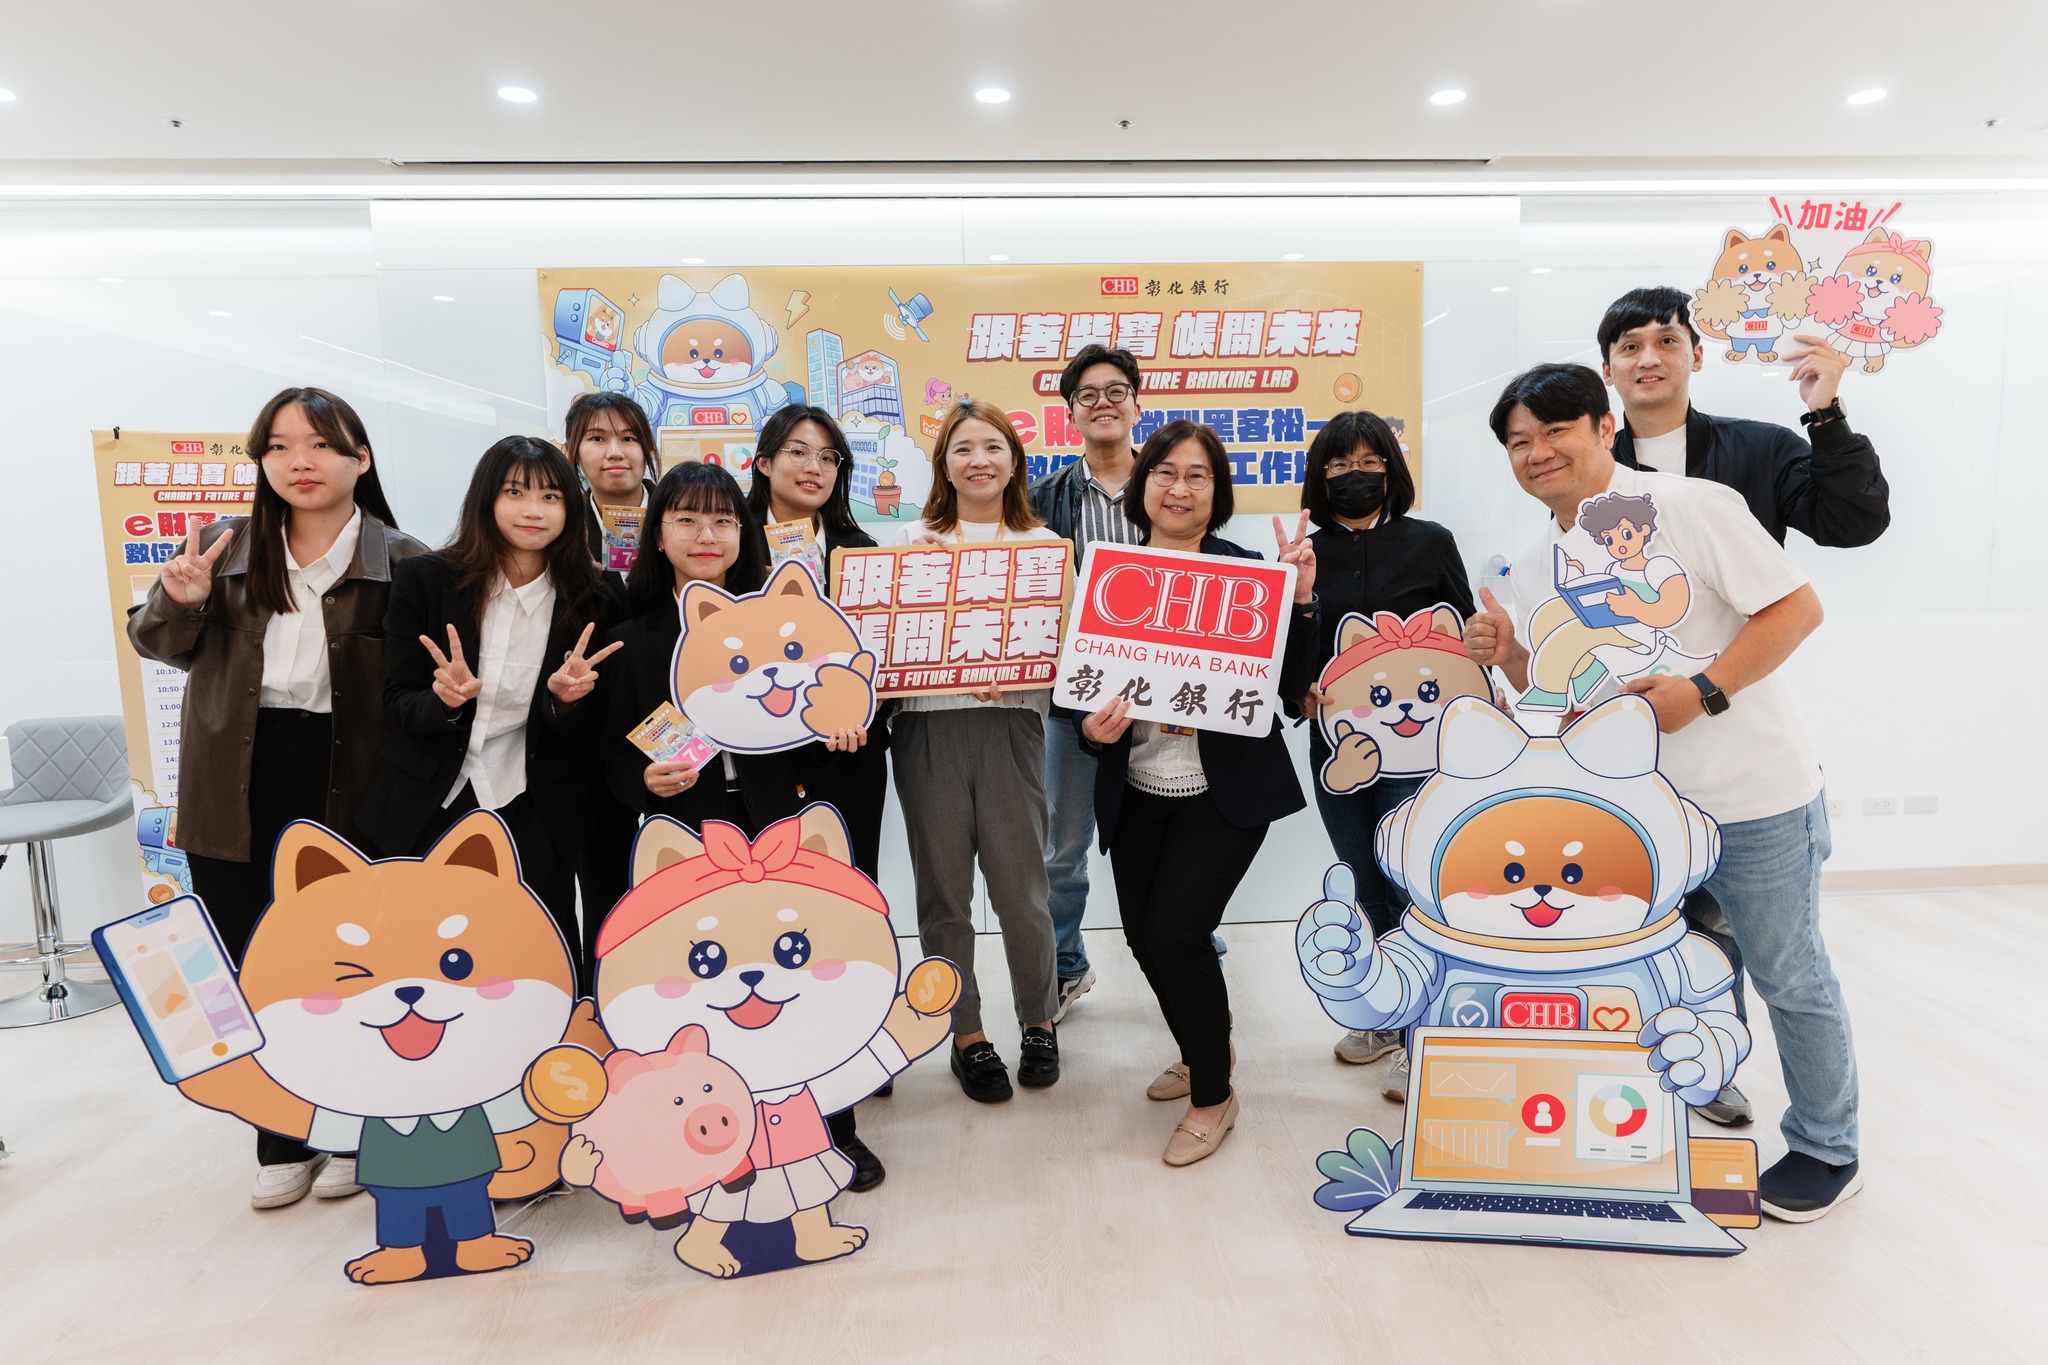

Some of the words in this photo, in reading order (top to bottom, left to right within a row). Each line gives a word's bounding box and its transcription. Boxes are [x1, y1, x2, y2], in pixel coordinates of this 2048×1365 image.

[1796, 199, 1868, 231] 加油
[1101, 278, 1138, 294] CHB
[1145, 279, 1230, 297] 彰化銀行
[1745, 321, 1768, 331] CHB
[1850, 324, 1875, 337] CHB
[1140, 371, 1182, 390] TURE
[1185, 370, 1257, 389] BANKING
[1260, 369, 1294, 388] LAB
[694, 411, 724, 424] CHB
[172, 442, 204, 454] CHB
[157, 491, 202, 501] CHAIBO'S
[204, 491, 240, 501] FUTURE
[837, 545, 1068, 610] 跟著柴寶
[1093, 563, 1270, 643] CHB
[1074, 638, 1147, 662] CHANG
[1154, 649, 1201, 669] HWA
[1209, 657, 1271, 679] BANK
[903, 668, 956, 687] FUTURE
[960, 665, 1020, 684] BANKING
[1025, 662, 1052, 680] LAB
[1066, 663, 1264, 727] 彰化銀行
[681, 747, 698, 763] 7
[1503, 1001, 1577, 1029] CHB
